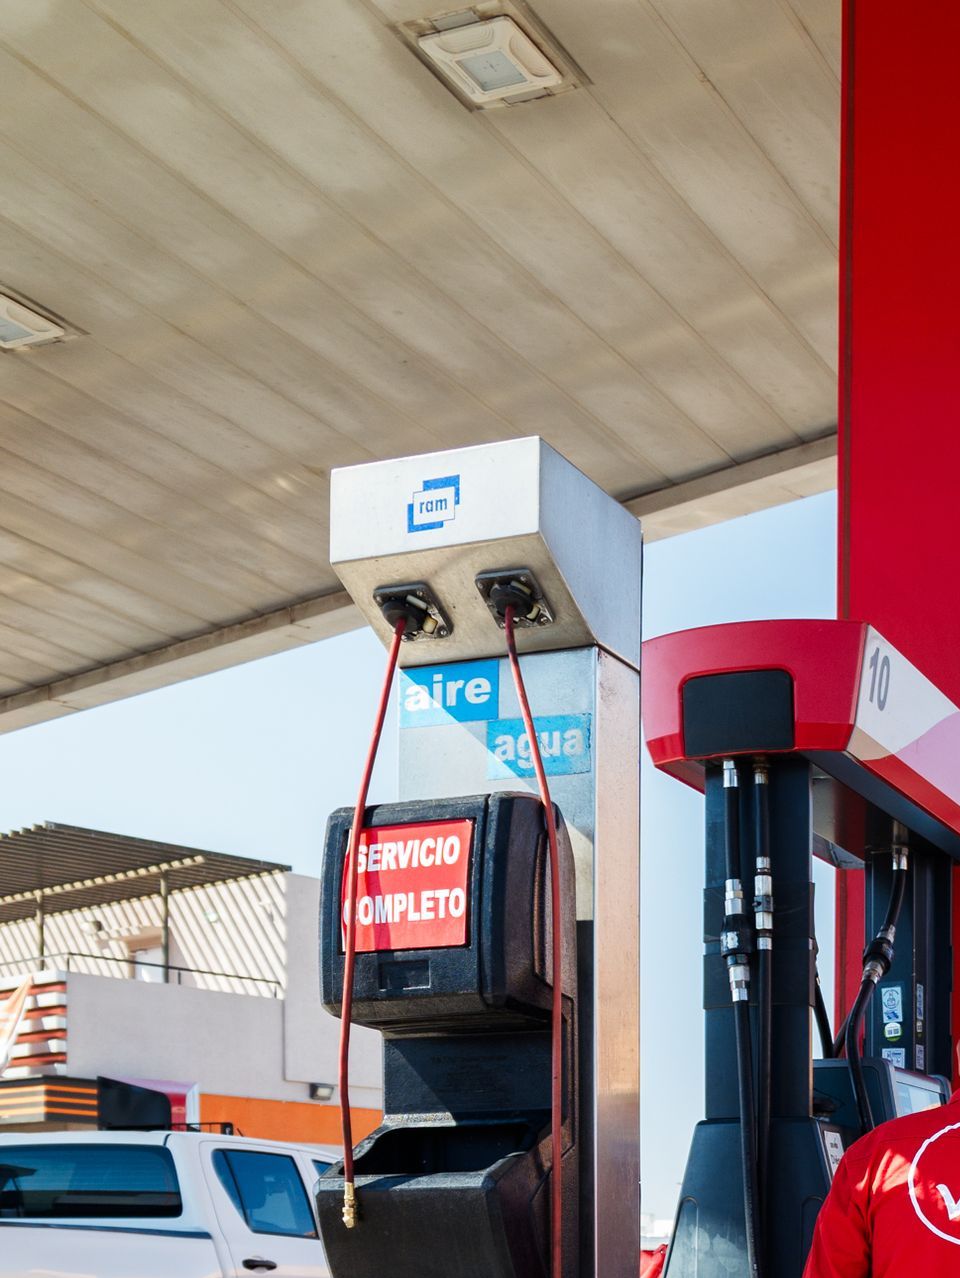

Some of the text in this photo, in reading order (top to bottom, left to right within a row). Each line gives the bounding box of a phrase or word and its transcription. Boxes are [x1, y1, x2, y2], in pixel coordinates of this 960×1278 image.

[419, 497, 448, 514] ram
[404, 673, 492, 711] aire
[869, 647, 890, 711] 10
[493, 728, 584, 769] agua
[357, 835, 461, 874] SERVICIO
